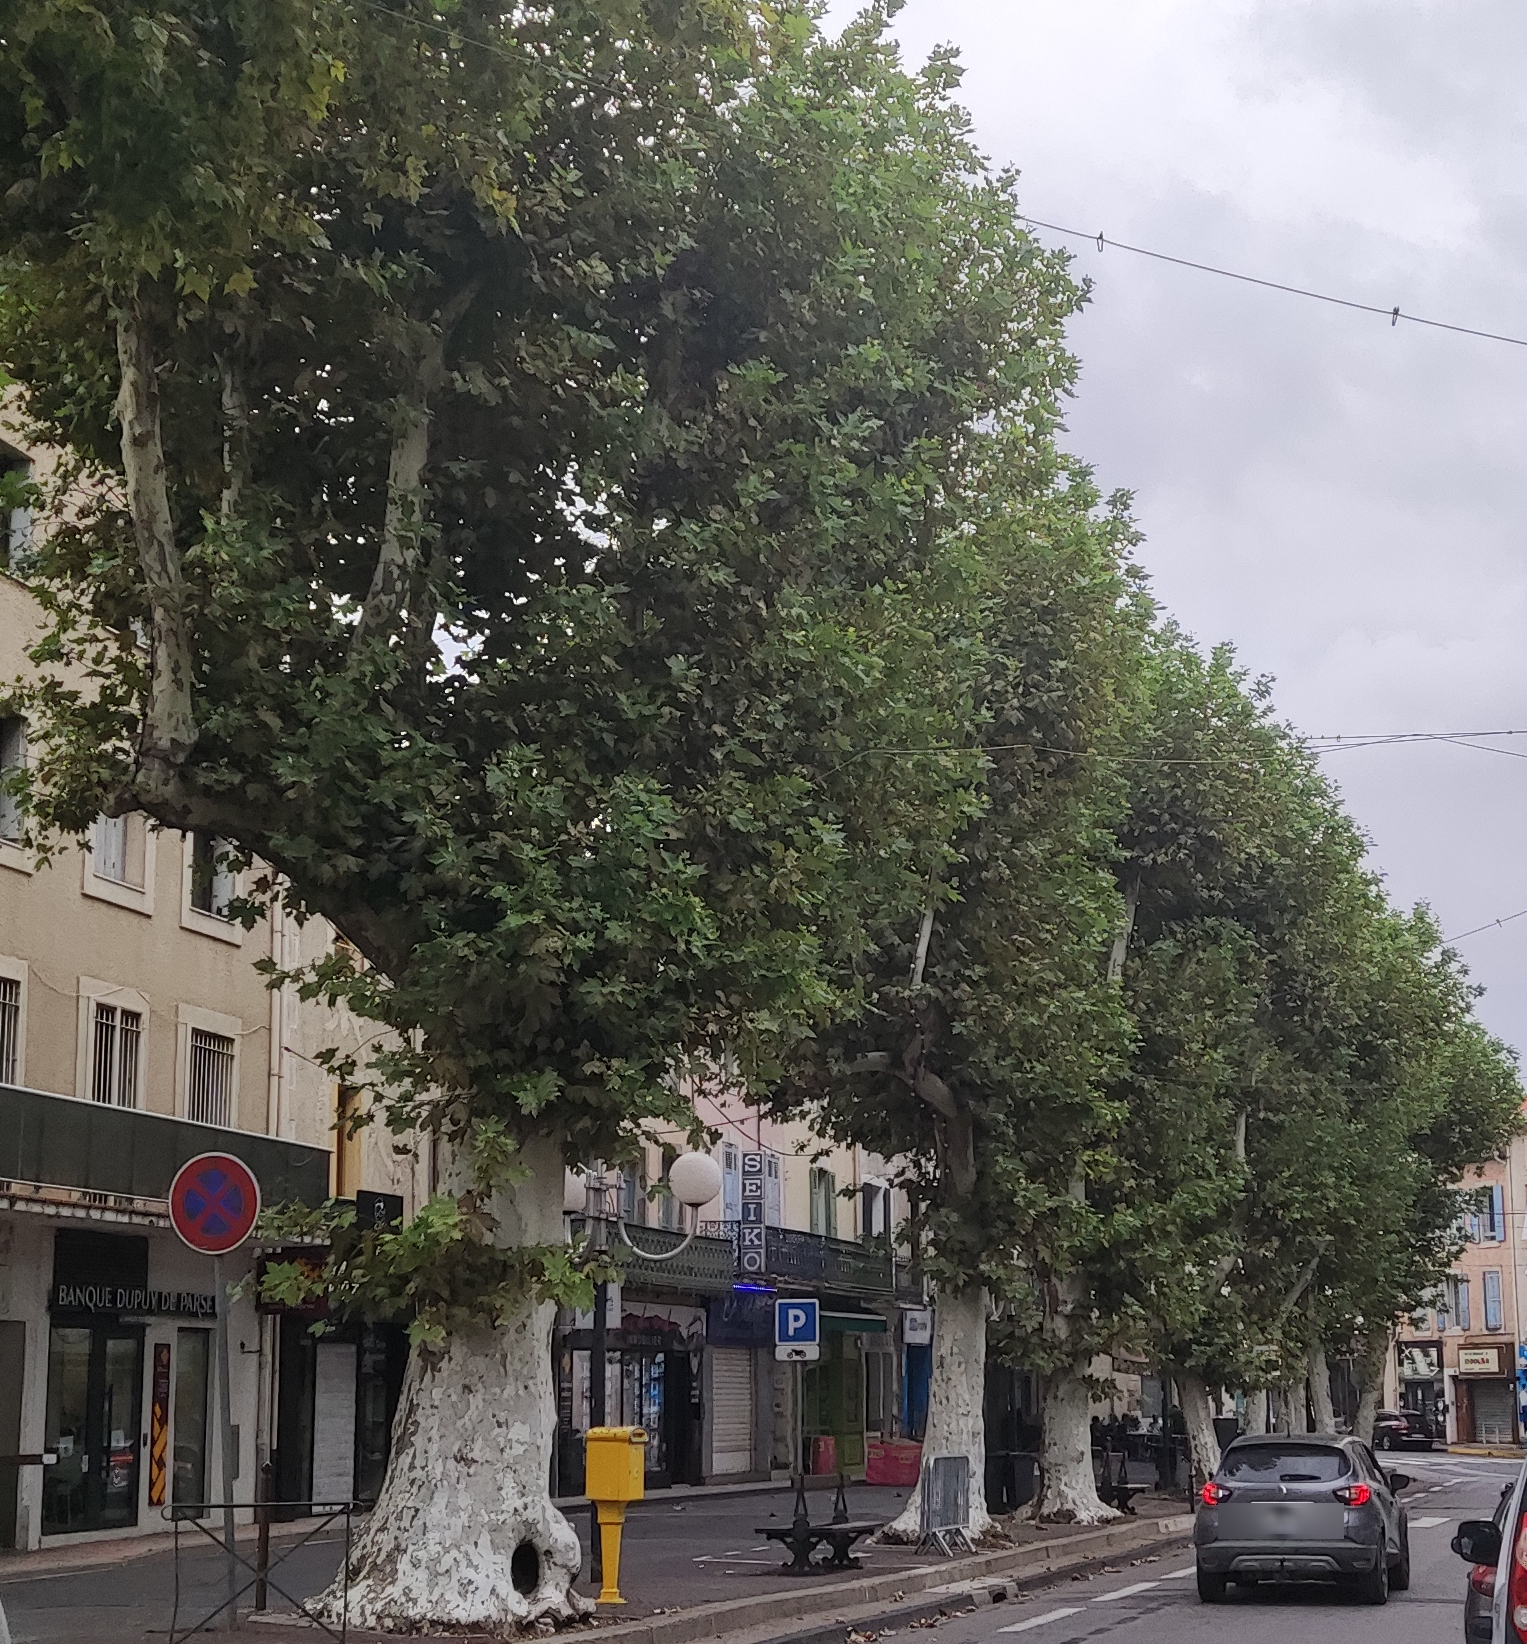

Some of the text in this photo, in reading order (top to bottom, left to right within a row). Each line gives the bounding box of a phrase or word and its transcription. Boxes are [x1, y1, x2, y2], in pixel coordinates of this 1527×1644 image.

[743, 1154, 762, 1272] SEIKO
[58, 1284, 113, 1313] BANQUE
[116, 1288, 158, 1312] DUPUY
[161, 1292, 177, 1311] DE
[787, 1308, 807, 1337] P
